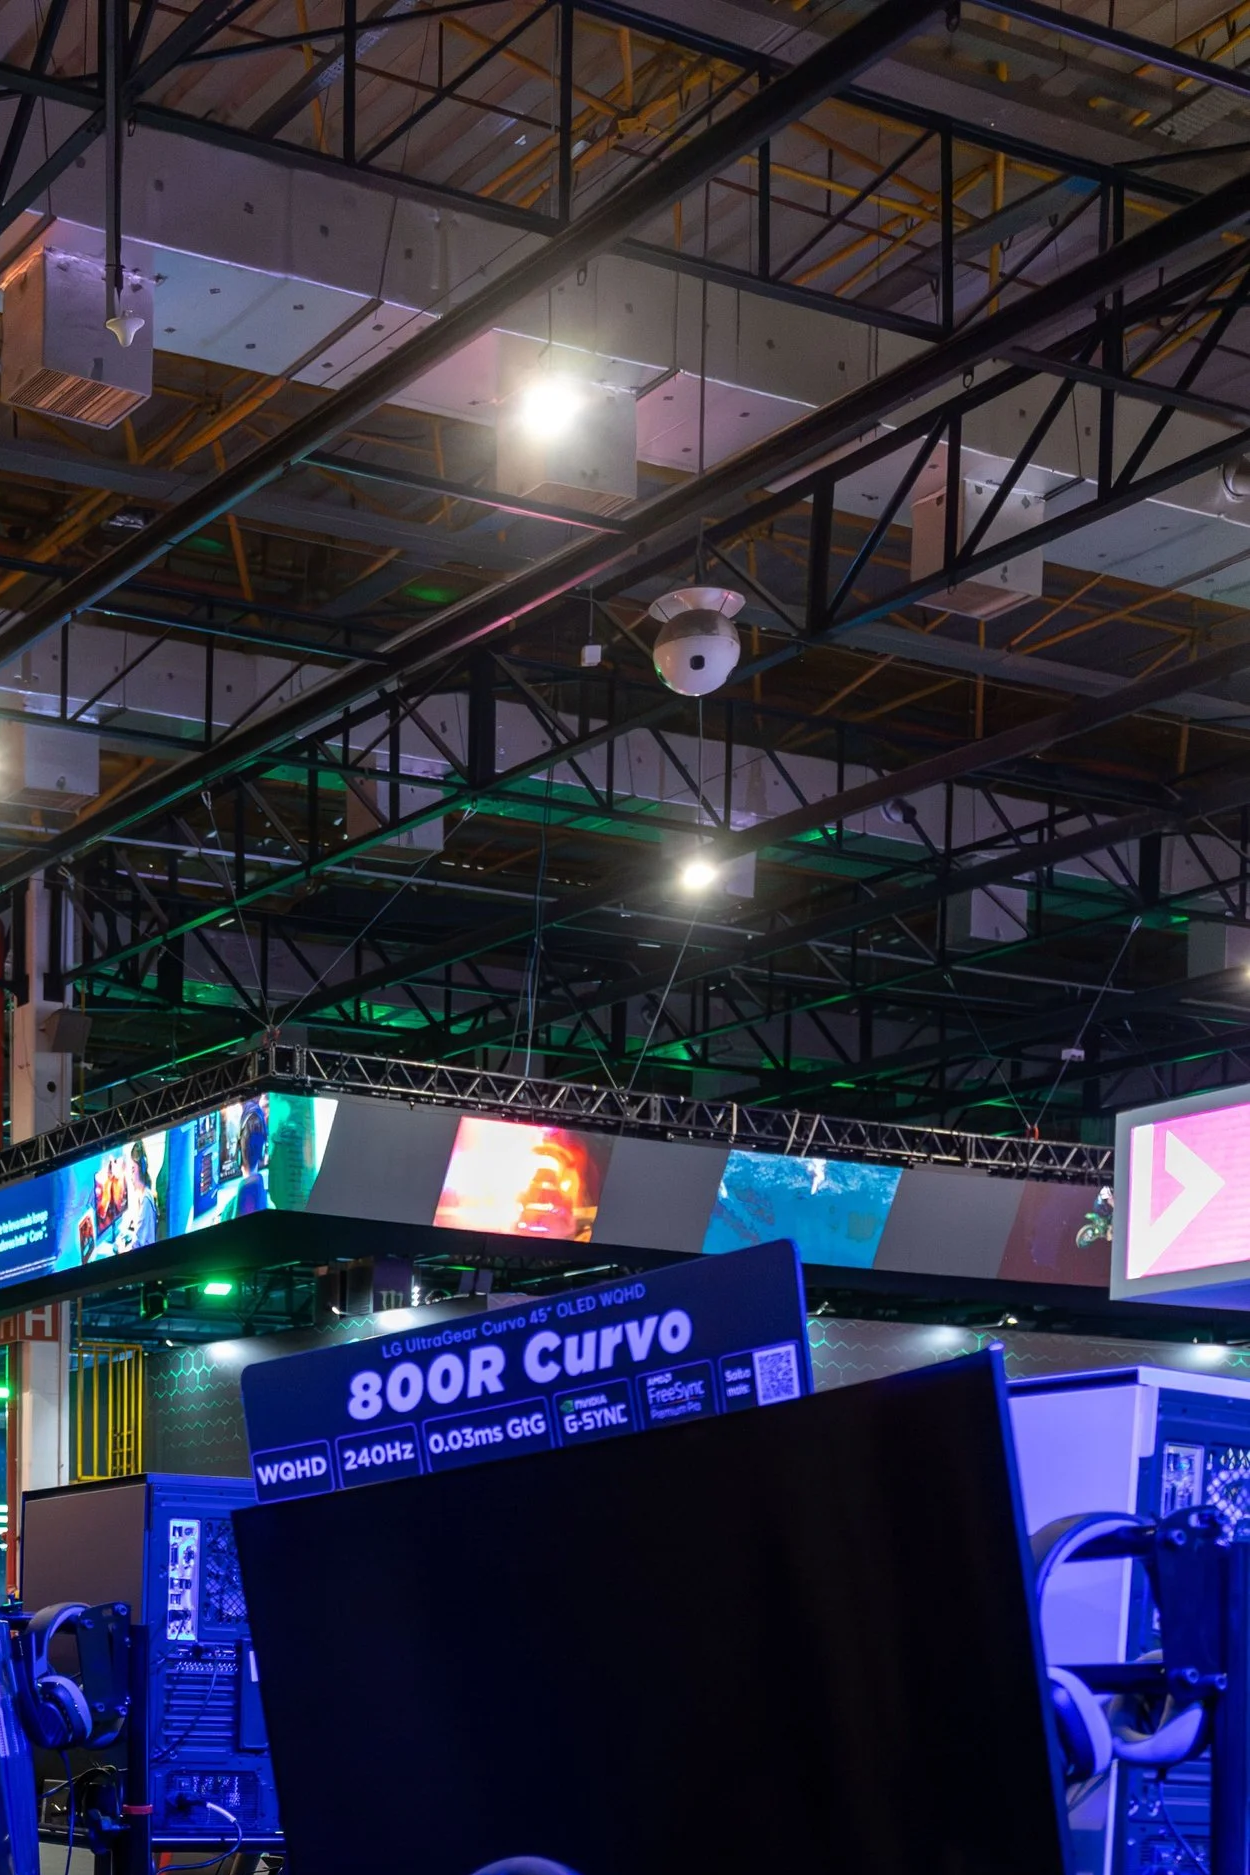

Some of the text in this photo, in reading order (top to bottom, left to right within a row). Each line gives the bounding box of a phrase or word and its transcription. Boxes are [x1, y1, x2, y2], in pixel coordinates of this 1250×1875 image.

[382, 1341, 403, 1359] LG
[405, 1326, 477, 1353] UltraGear
[481, 1315, 526, 1336] Curvo
[555, 1298, 597, 1319] OLED
[598, 1282, 646, 1308] WQHD
[347, 1308, 692, 1421] 800R Curvo
[429, 1413, 546, 1454] 0.03ms GtG
[563, 1404, 628, 1435] G-SYNC
[257, 1456, 327, 1486] WQHD
[343, 1441, 415, 1471] 240Hz
